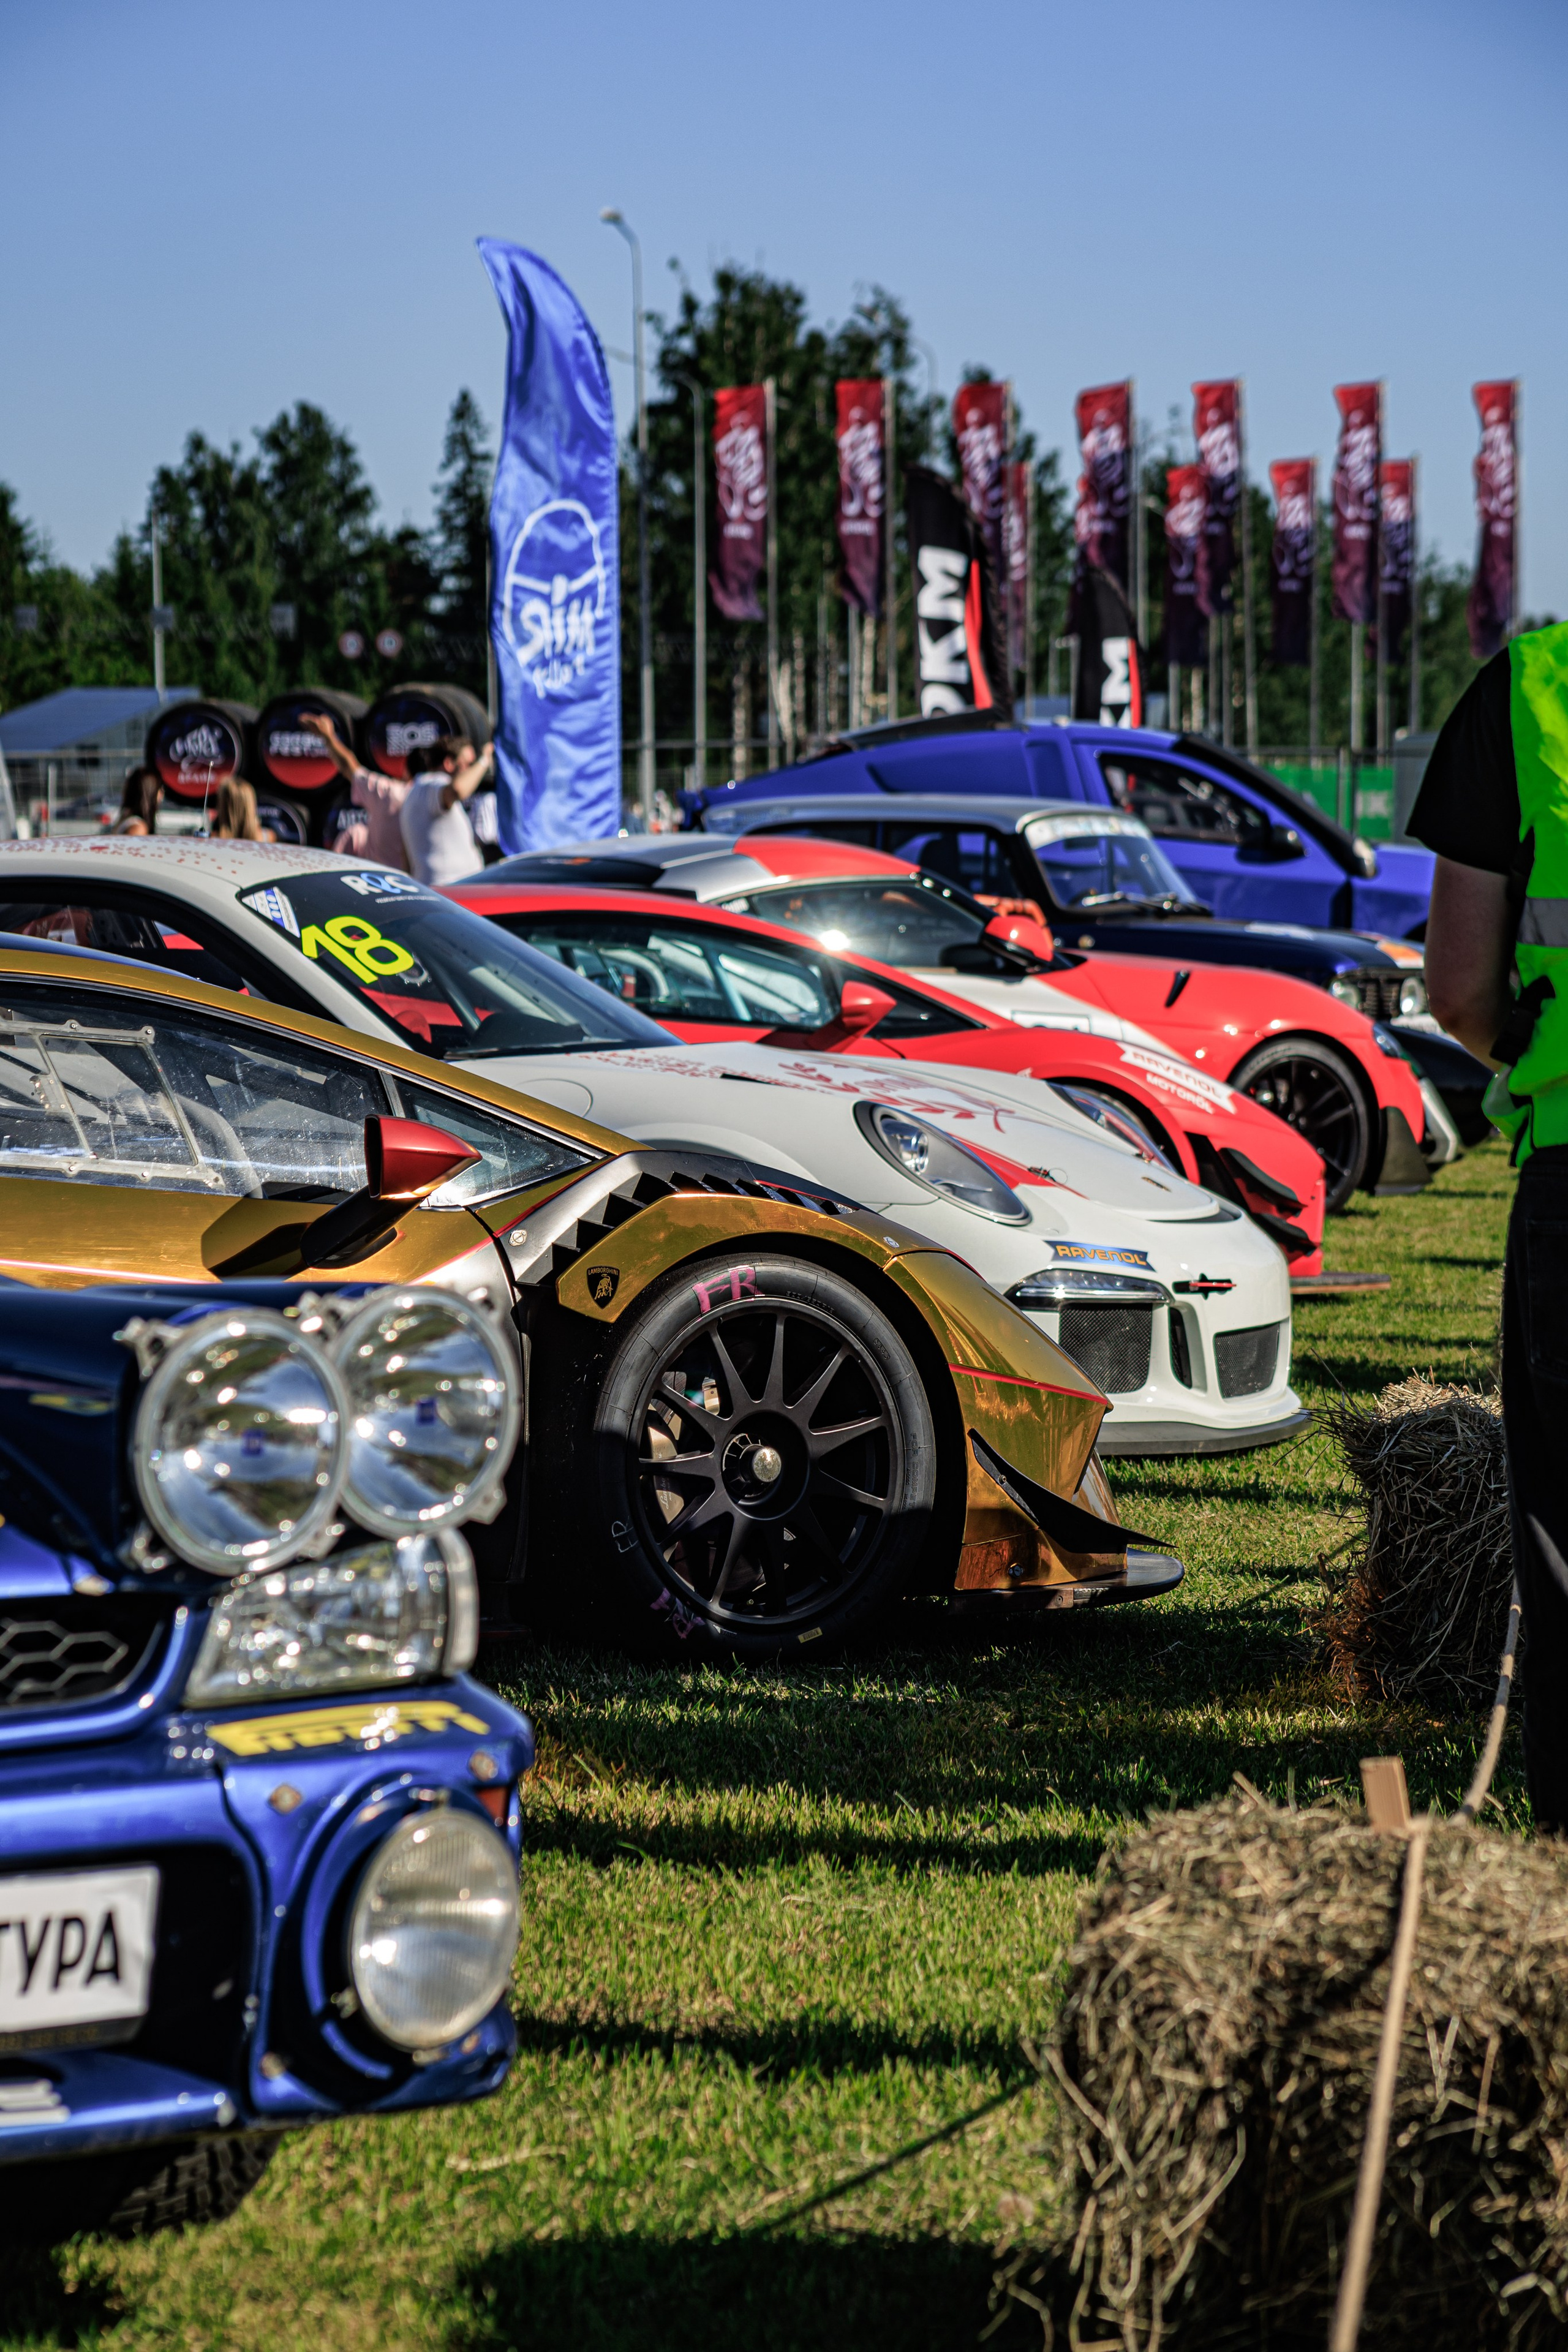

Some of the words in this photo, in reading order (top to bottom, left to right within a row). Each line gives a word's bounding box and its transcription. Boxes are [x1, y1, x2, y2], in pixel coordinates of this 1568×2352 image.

[301, 915, 414, 985] 18
[1132, 1051, 1221, 1099] RAVENOL
[588, 1267, 619, 1276] LAMBORGHINI
[1055, 1245, 1147, 1266] RAVENOL
[692, 1264, 765, 1314] FR
[910, 1433, 919, 1457] FOR
